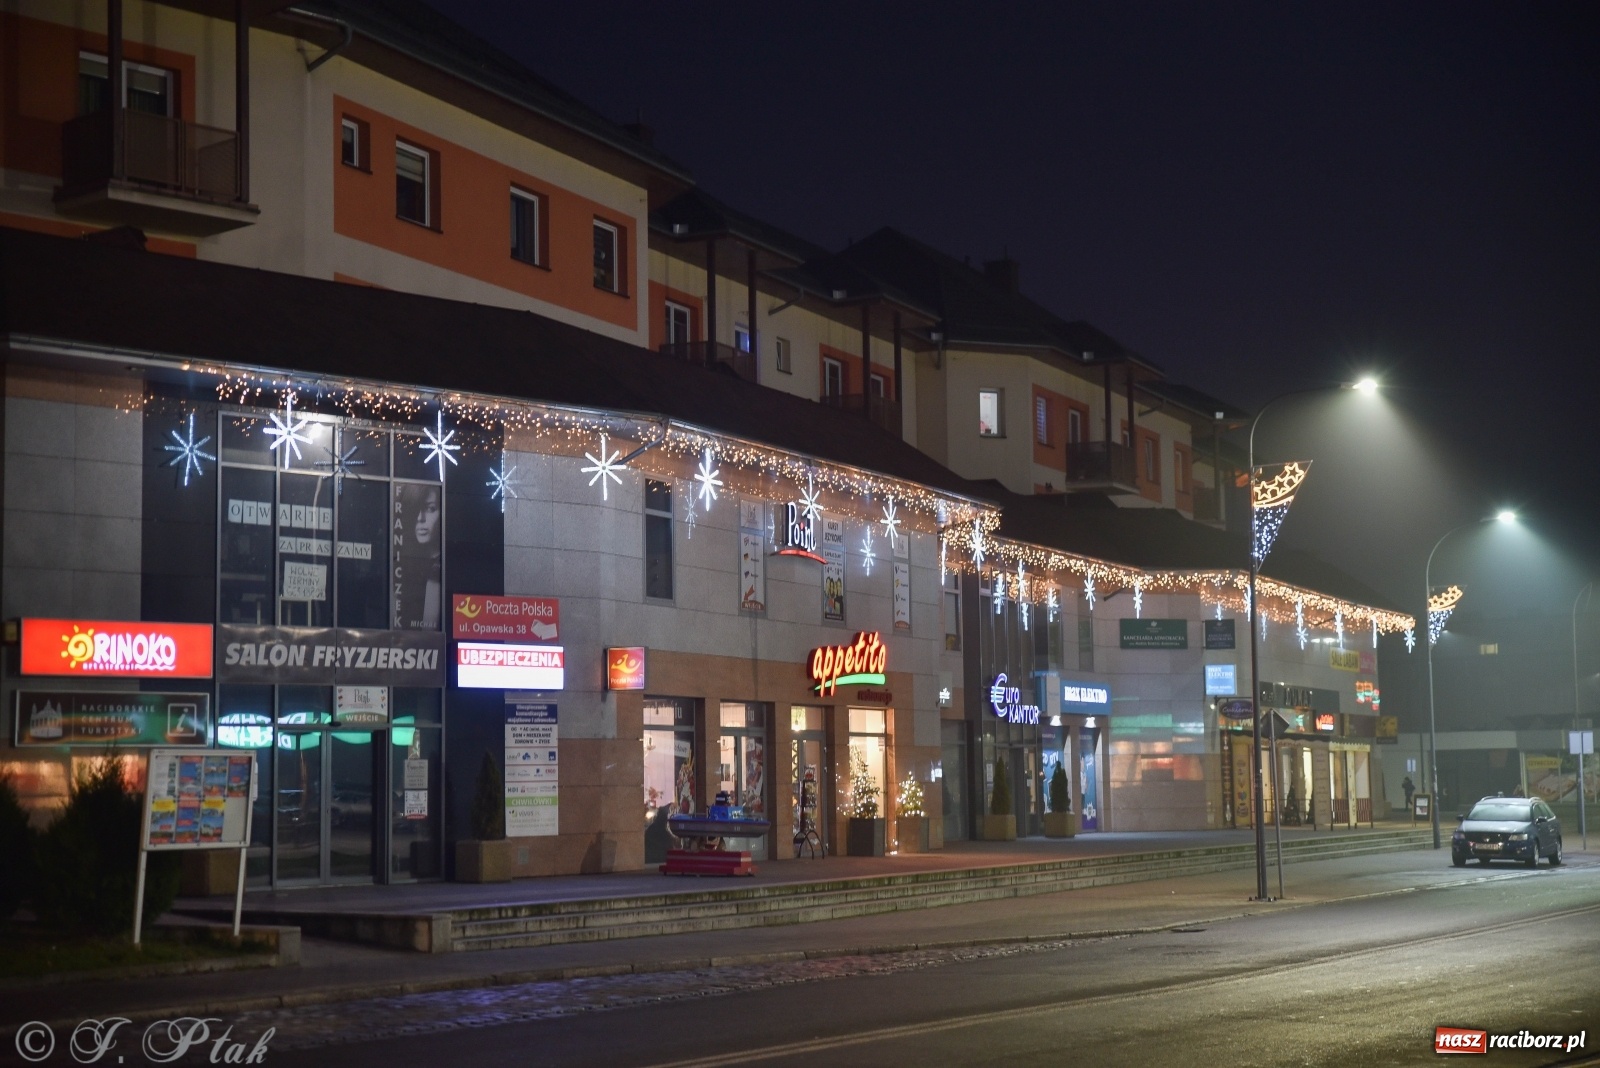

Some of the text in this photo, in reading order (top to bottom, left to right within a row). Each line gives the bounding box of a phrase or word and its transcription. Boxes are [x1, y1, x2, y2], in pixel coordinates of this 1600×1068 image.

[230, 502, 331, 526] OTWARTE
[787, 501, 816, 552] Point
[279, 540, 370, 558] ZAPRASZAMY
[393, 485, 404, 628] FRANICZEK
[486, 600, 553, 617] Poczta Polska
[459, 623, 527, 634] ul. Opawska 38
[225, 643, 439, 670] SALON FRYZJERSKI
[460, 650, 562, 667] UBEZPIECZENIA
[813, 631, 886, 697] appetito
[81, 704, 155, 712] RACIBORSKIE
[1009, 704, 1039, 725] KANTOR
[81, 715, 133, 723] CENTRUM
[345, 714, 379, 722] WEJŚCIE
[81, 727, 143, 735] TURYSTYKI
